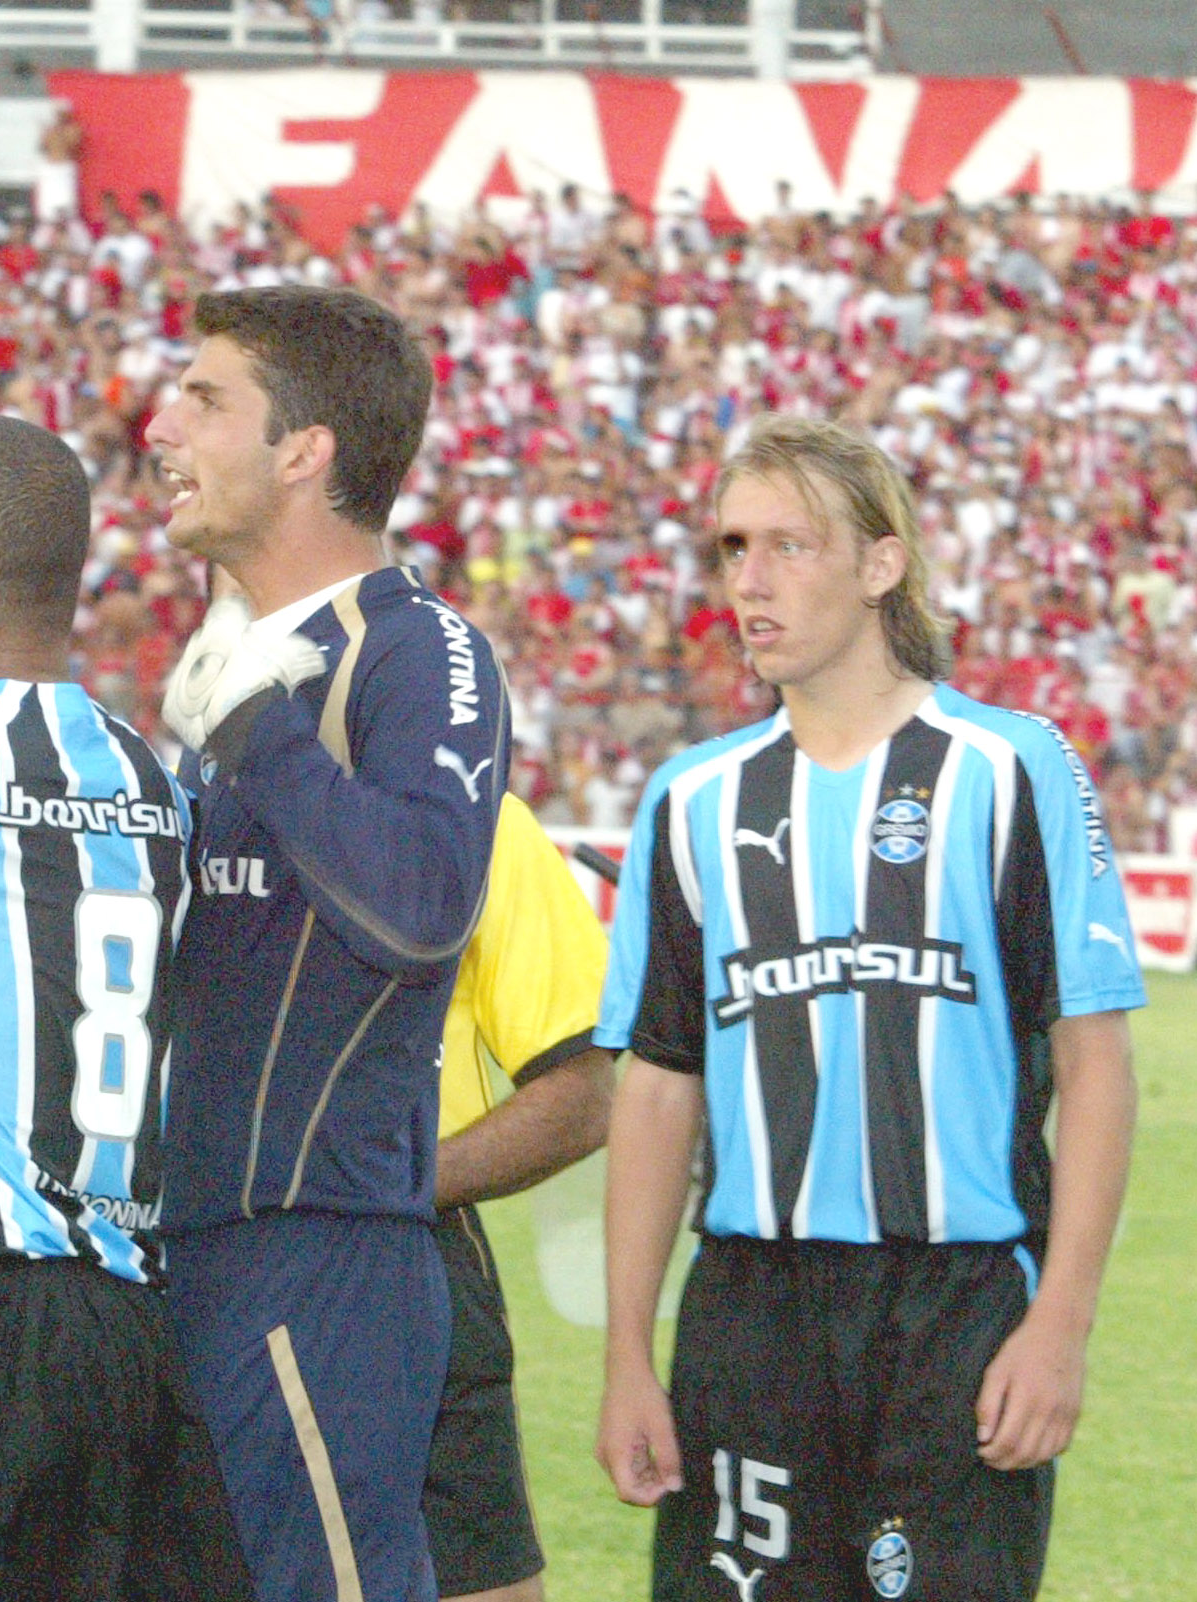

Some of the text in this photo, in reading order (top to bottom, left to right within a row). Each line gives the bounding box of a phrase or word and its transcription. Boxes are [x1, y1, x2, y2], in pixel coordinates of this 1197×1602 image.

[178, 70, 1197, 236] FANA
[71, 888, 163, 1143] 8
[711, 1447, 792, 1560] 15
